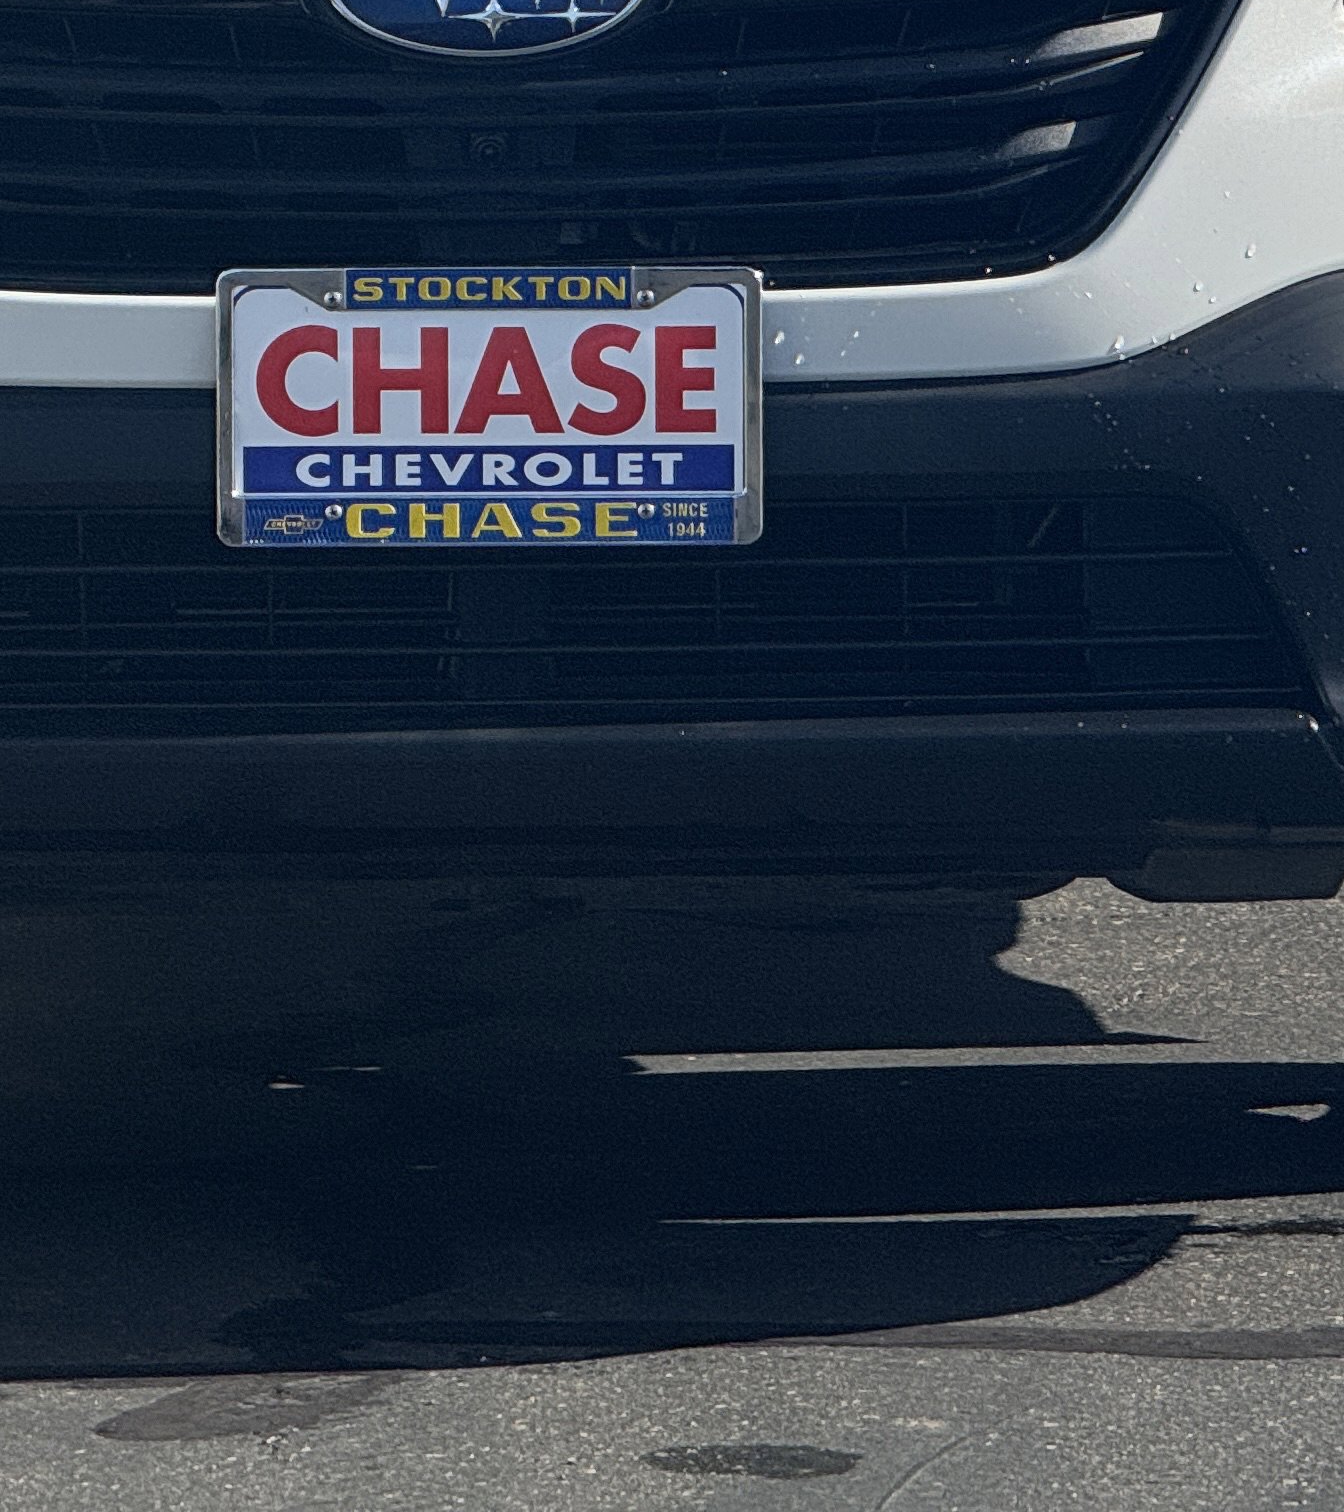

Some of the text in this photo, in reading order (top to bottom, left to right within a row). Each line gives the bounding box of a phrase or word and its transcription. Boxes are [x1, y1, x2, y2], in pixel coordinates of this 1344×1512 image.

[352, 276, 627, 301] STOCKTON
[256, 322, 717, 437] CHASE
[296, 453, 683, 487] CHEVROLET
[346, 502, 638, 538] CHASE
[662, 502, 710, 519] SINCE
[667, 522, 706, 538] 1944
